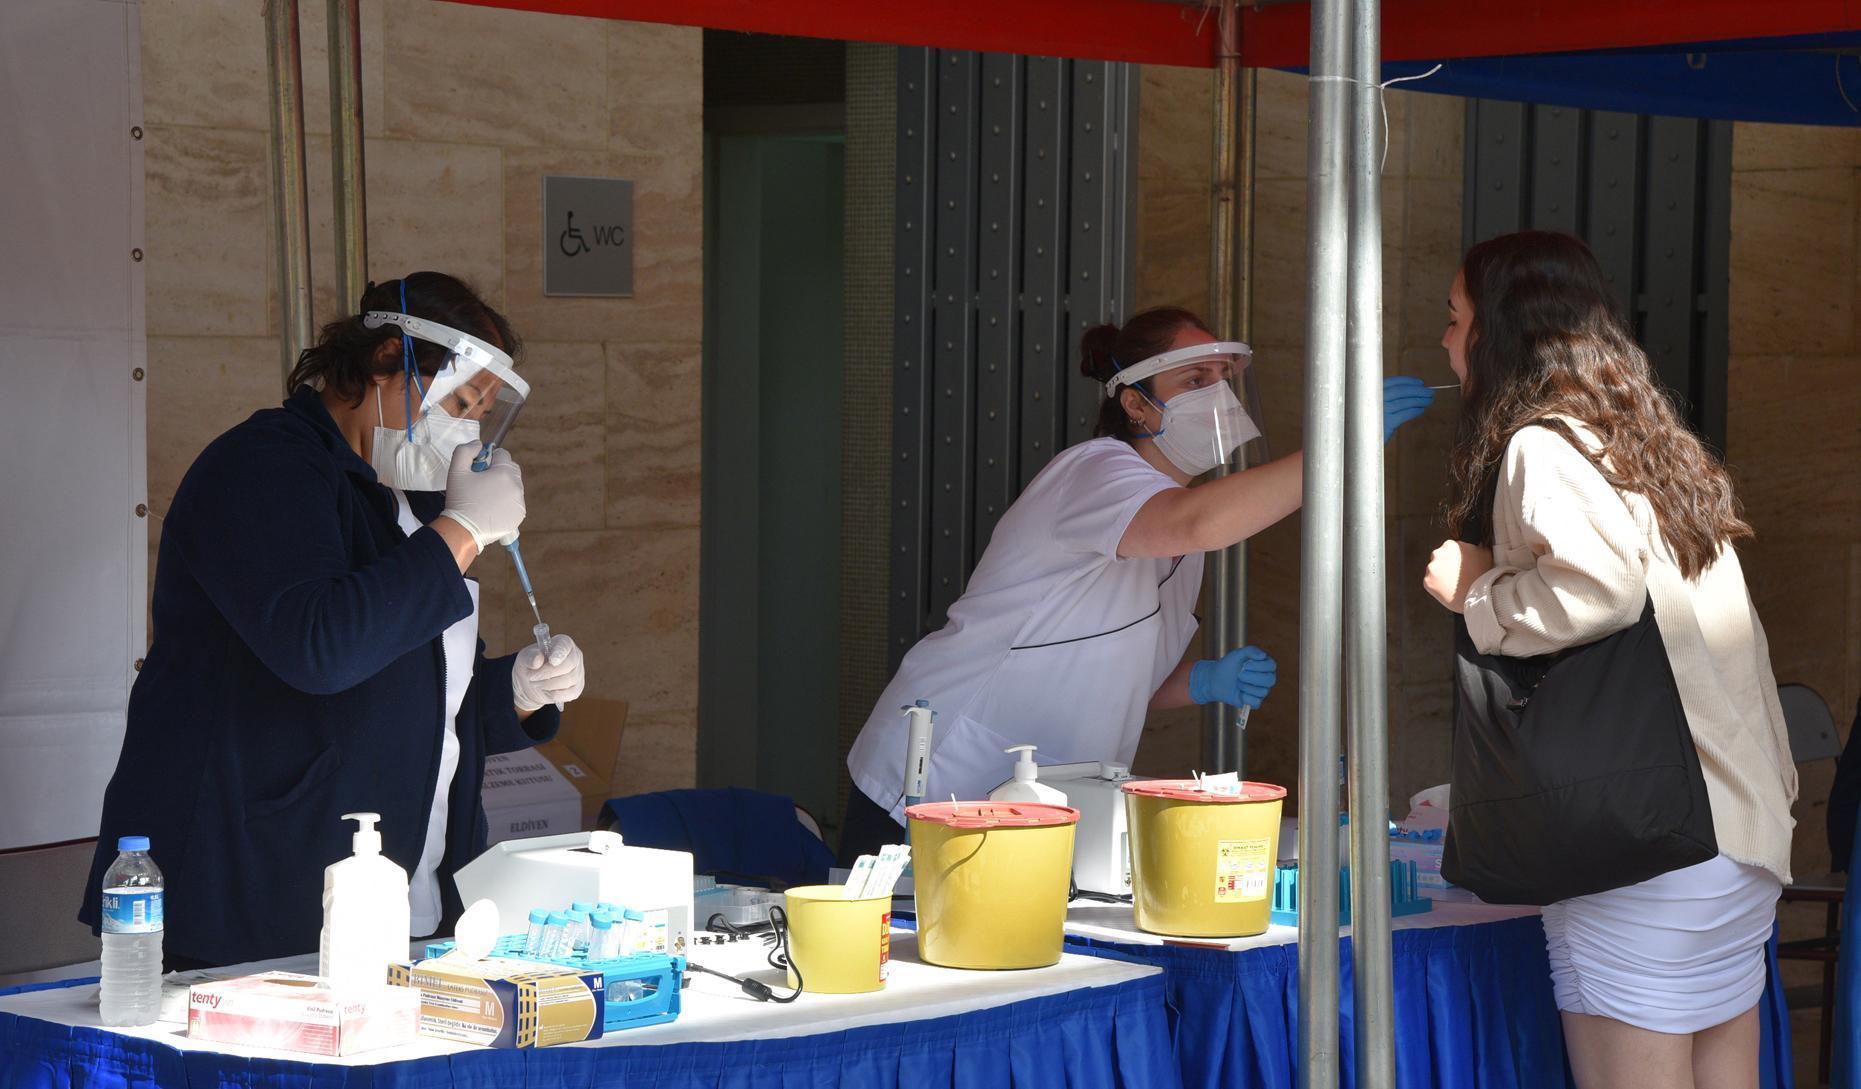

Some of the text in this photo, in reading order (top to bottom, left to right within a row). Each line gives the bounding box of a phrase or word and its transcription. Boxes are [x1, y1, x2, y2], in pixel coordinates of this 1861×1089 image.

[593, 225, 624, 247] WC
[510, 818, 549, 833] ELDİVEN
[593, 976, 603, 989] M
[191, 991, 222, 1009] tenty
[484, 1000, 495, 1017] M
